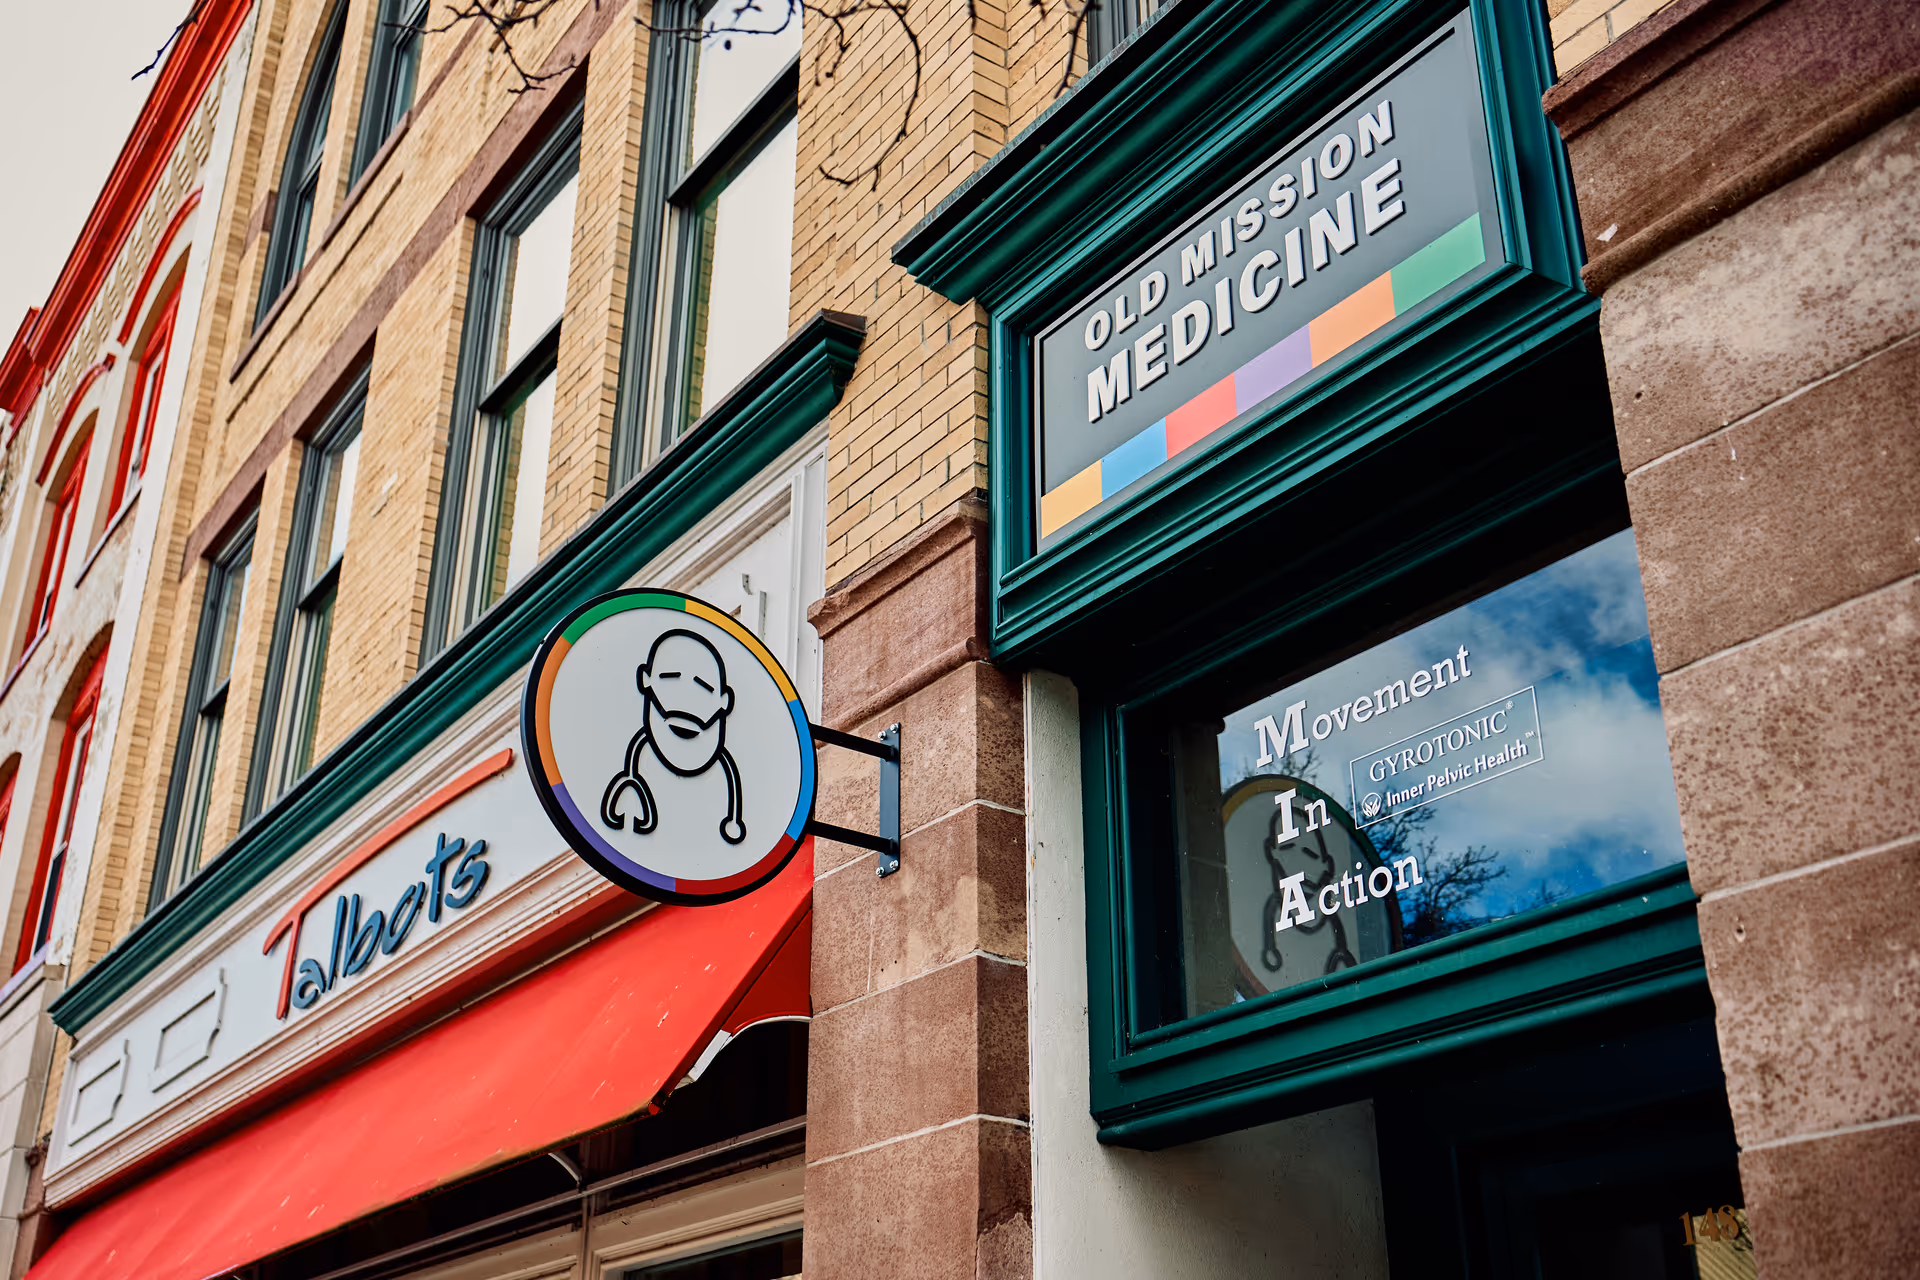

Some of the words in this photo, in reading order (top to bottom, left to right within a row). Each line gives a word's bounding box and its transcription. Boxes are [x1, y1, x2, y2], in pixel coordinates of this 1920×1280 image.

[1084, 270, 1168, 351] OLD
[1181, 100, 1395, 287] MISSION
[1088, 158, 1405, 423] MEDICINE
[1254, 644, 1472, 768] Movement
[1274, 788, 1331, 844] In
[1386, 782, 1425, 807] Inner
[1427, 763, 1473, 792] Pelvic
[263, 747, 515, 1021] Talbots
[1275, 855, 1423, 932] Action
[1679, 1204, 1739, 1246] 148
